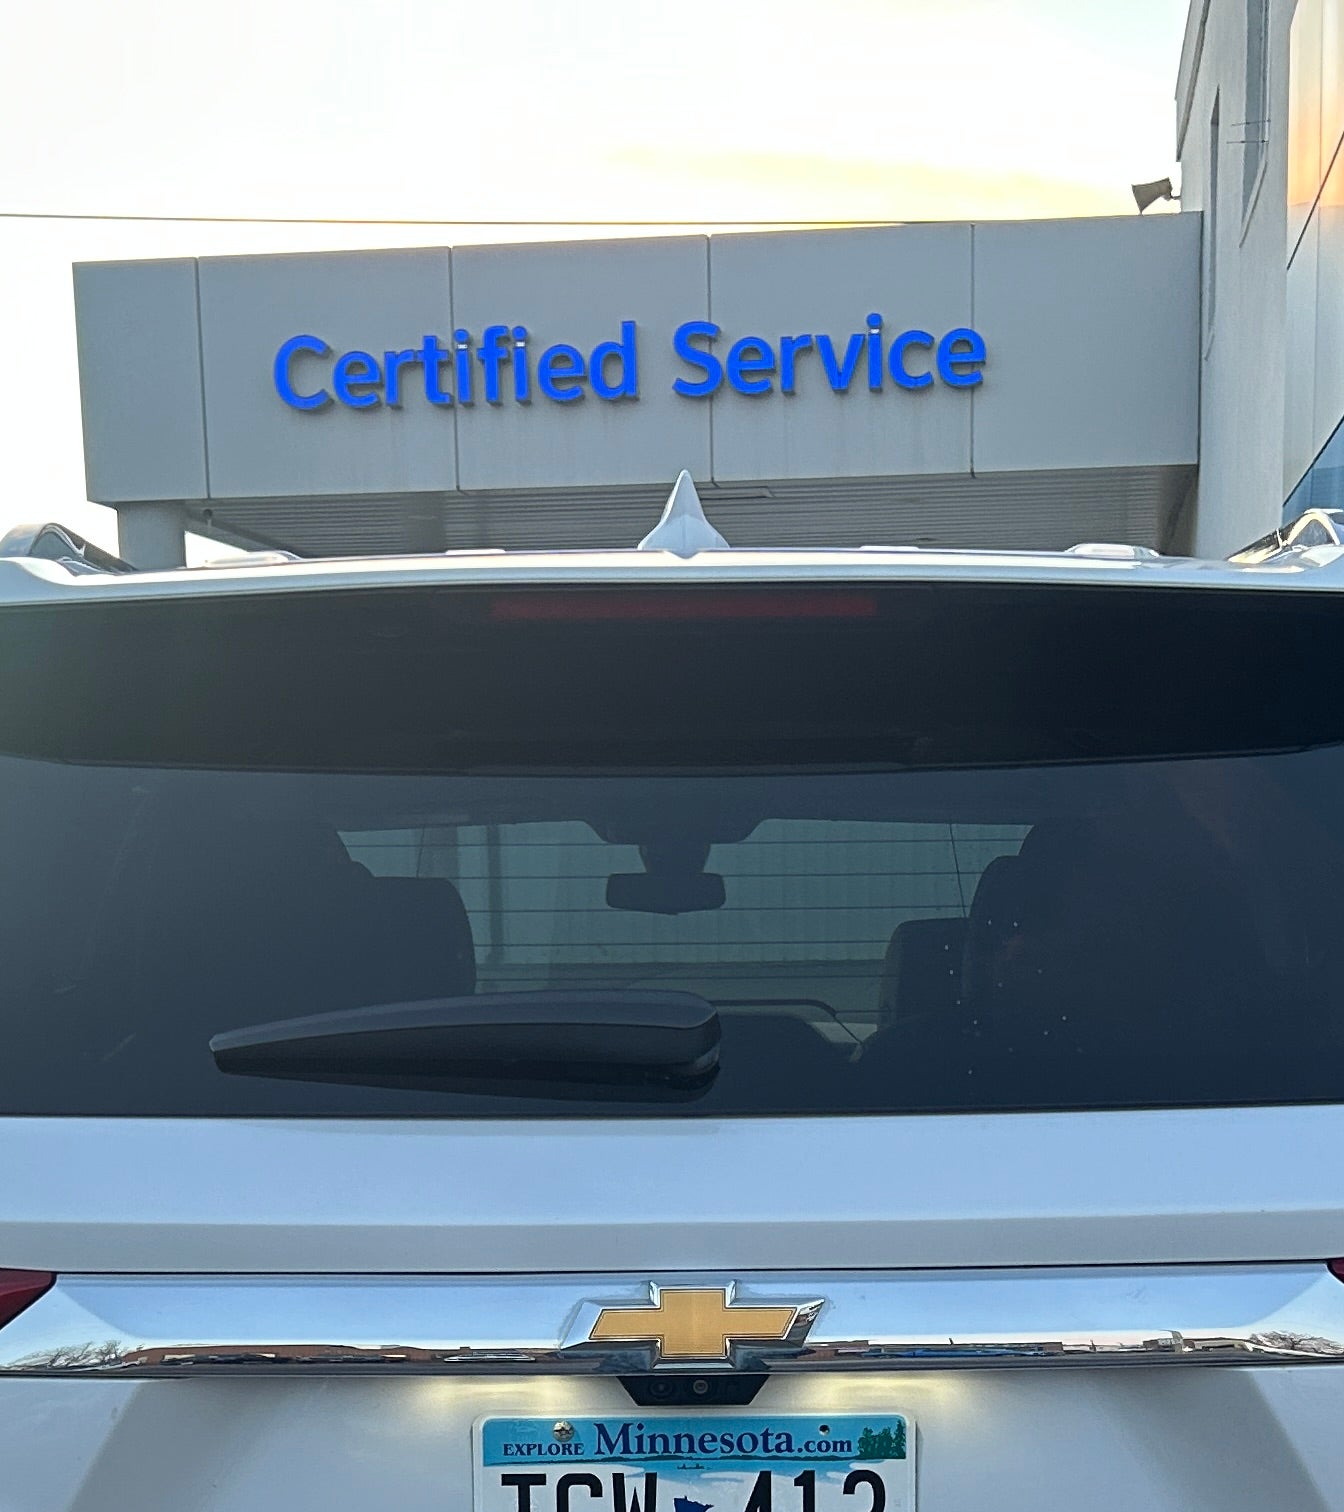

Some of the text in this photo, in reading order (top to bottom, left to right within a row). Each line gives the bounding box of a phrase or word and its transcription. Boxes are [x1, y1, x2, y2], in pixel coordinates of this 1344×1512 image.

[272, 312, 988, 411] Certified Service
[503, 1422, 853, 1457] EXPLORE Minnesota.com
